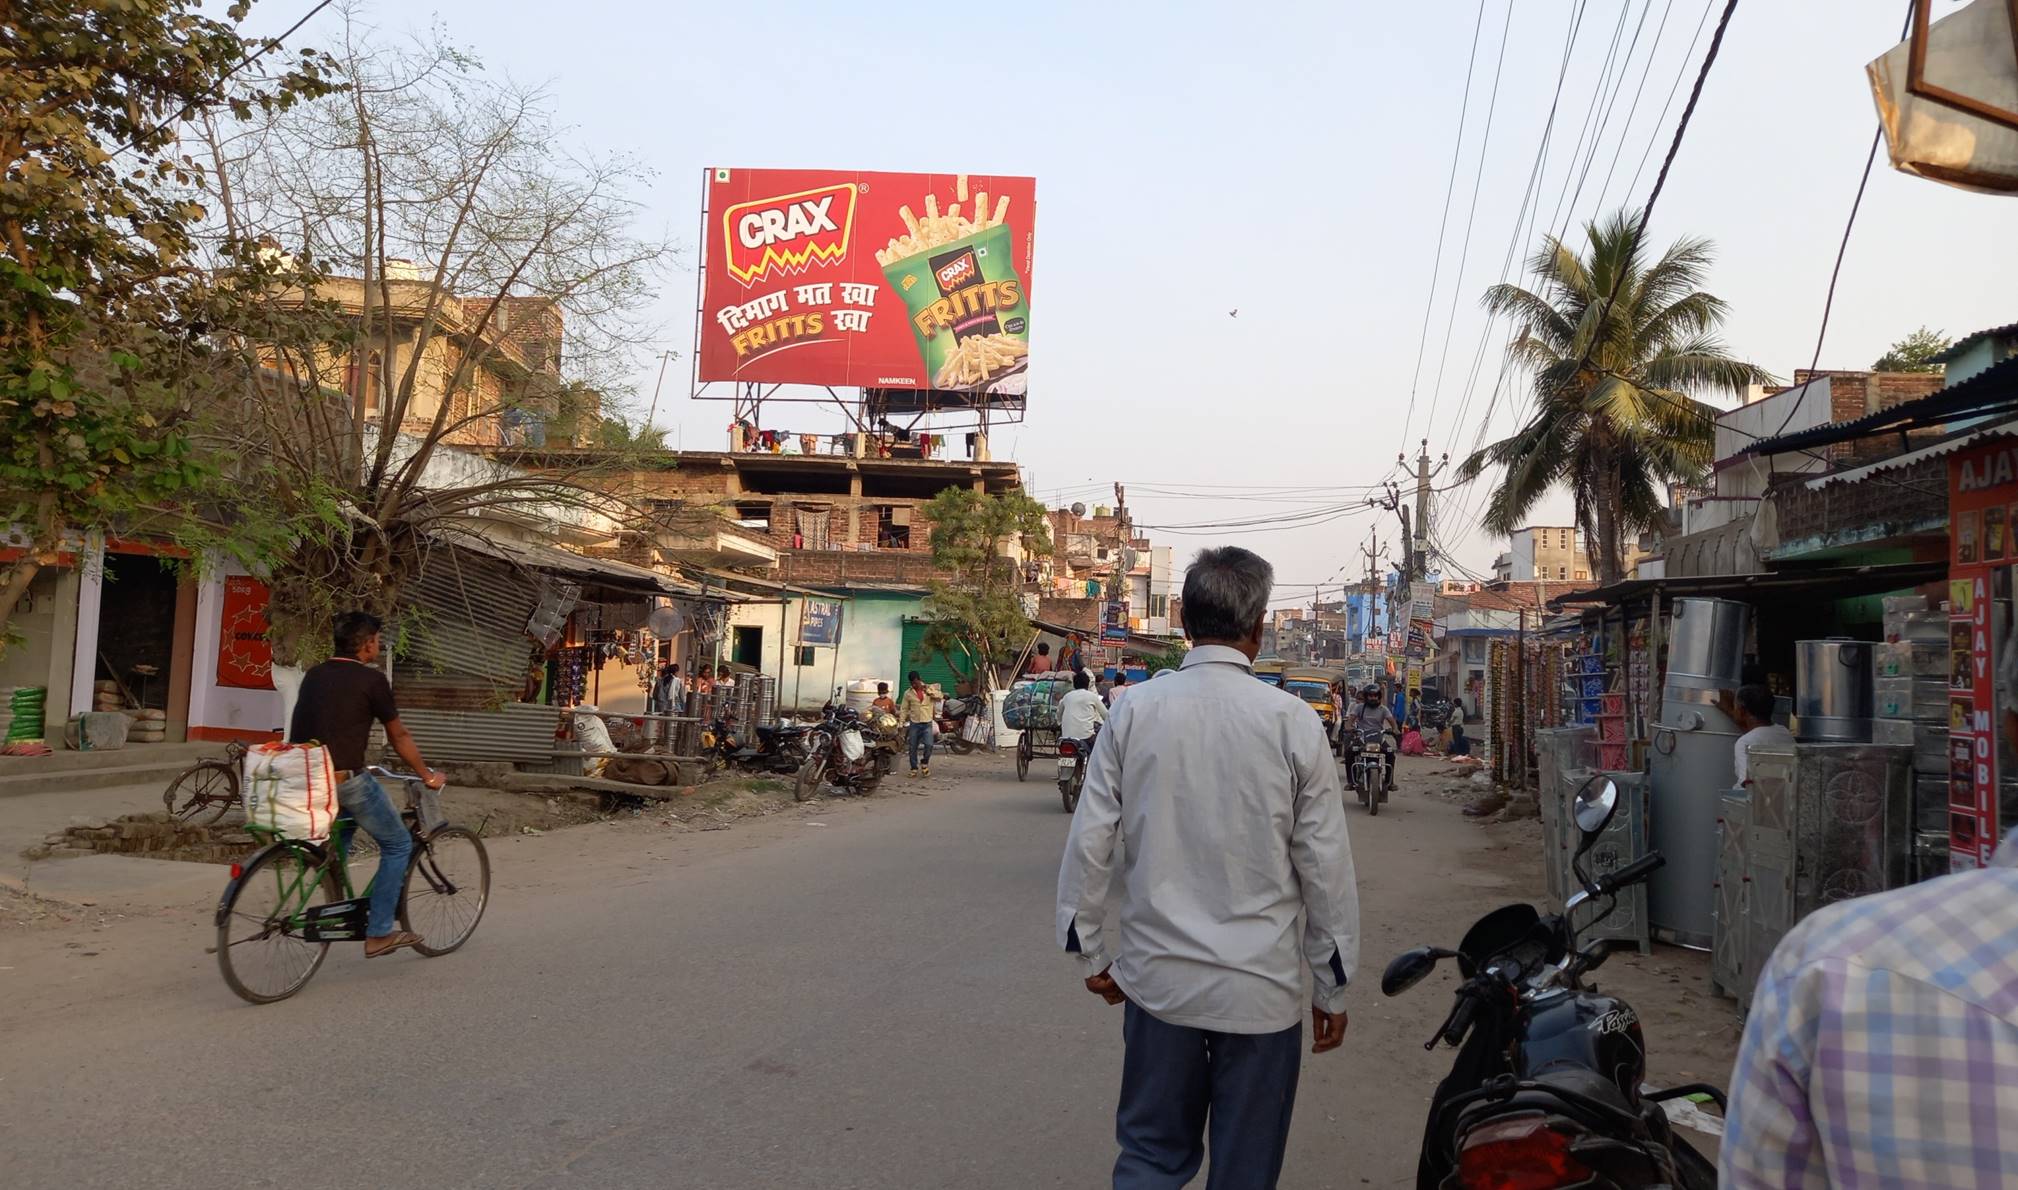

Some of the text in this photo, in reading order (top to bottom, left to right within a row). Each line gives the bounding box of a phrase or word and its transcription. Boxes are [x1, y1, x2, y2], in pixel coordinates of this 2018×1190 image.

[738, 196, 838, 249] CRAX
[941, 258, 970, 282] CRAX
[716, 290, 789, 335] दिमाग
[793, 283, 833, 306] मत
[840, 282, 879, 307] खा
[730, 310, 872, 356] FRITTS खा
[913, 280, 1020, 338] FRITTS
[878, 377, 916, 385] NAMKEEN
[1974, 577, 1992, 866] AJAY MOBILE
